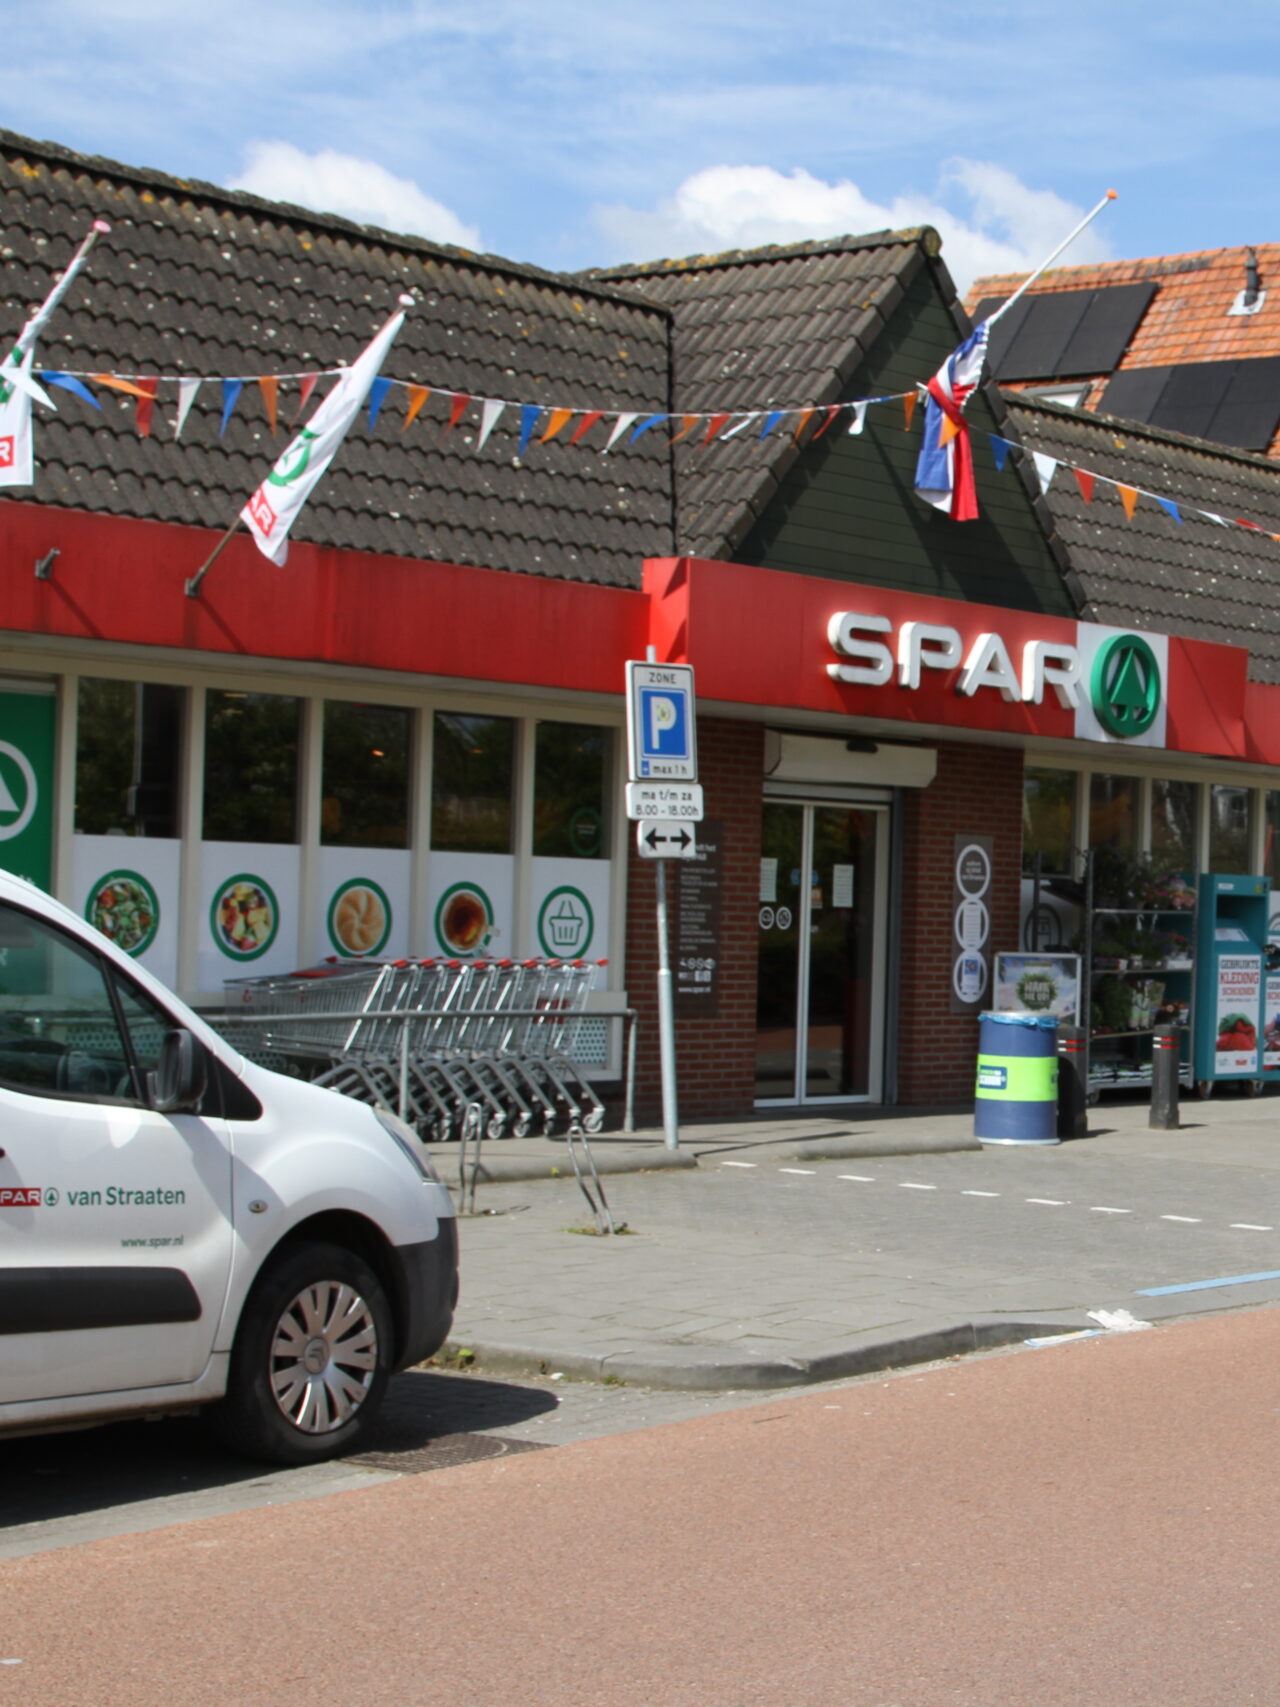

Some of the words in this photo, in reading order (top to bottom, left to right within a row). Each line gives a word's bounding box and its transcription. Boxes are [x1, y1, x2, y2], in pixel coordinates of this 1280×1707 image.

[826, 611, 1083, 710] SPAR
[649, 672, 677, 684] ZONE
[650, 696, 677, 750] P
[652, 764, 672, 774] max
[681, 764, 688, 775] h
[641, 791, 656, 800] ma
[659, 789, 678, 800] t/m
[681, 792, 692, 801] za
[635, 804, 658, 815] 8.00
[667, 804, 699, 816] 18.00h
[1220, 959, 1259, 970] GEBRUIKTE
[1219, 972, 1260, 985] KLEDING
[0, 1191, 41, 1202] PAR
[67, 1192, 101, 1205] van
[105, 1187, 186, 1205] Straaten
[121, 1236, 184, 1248] www.spar.nl
